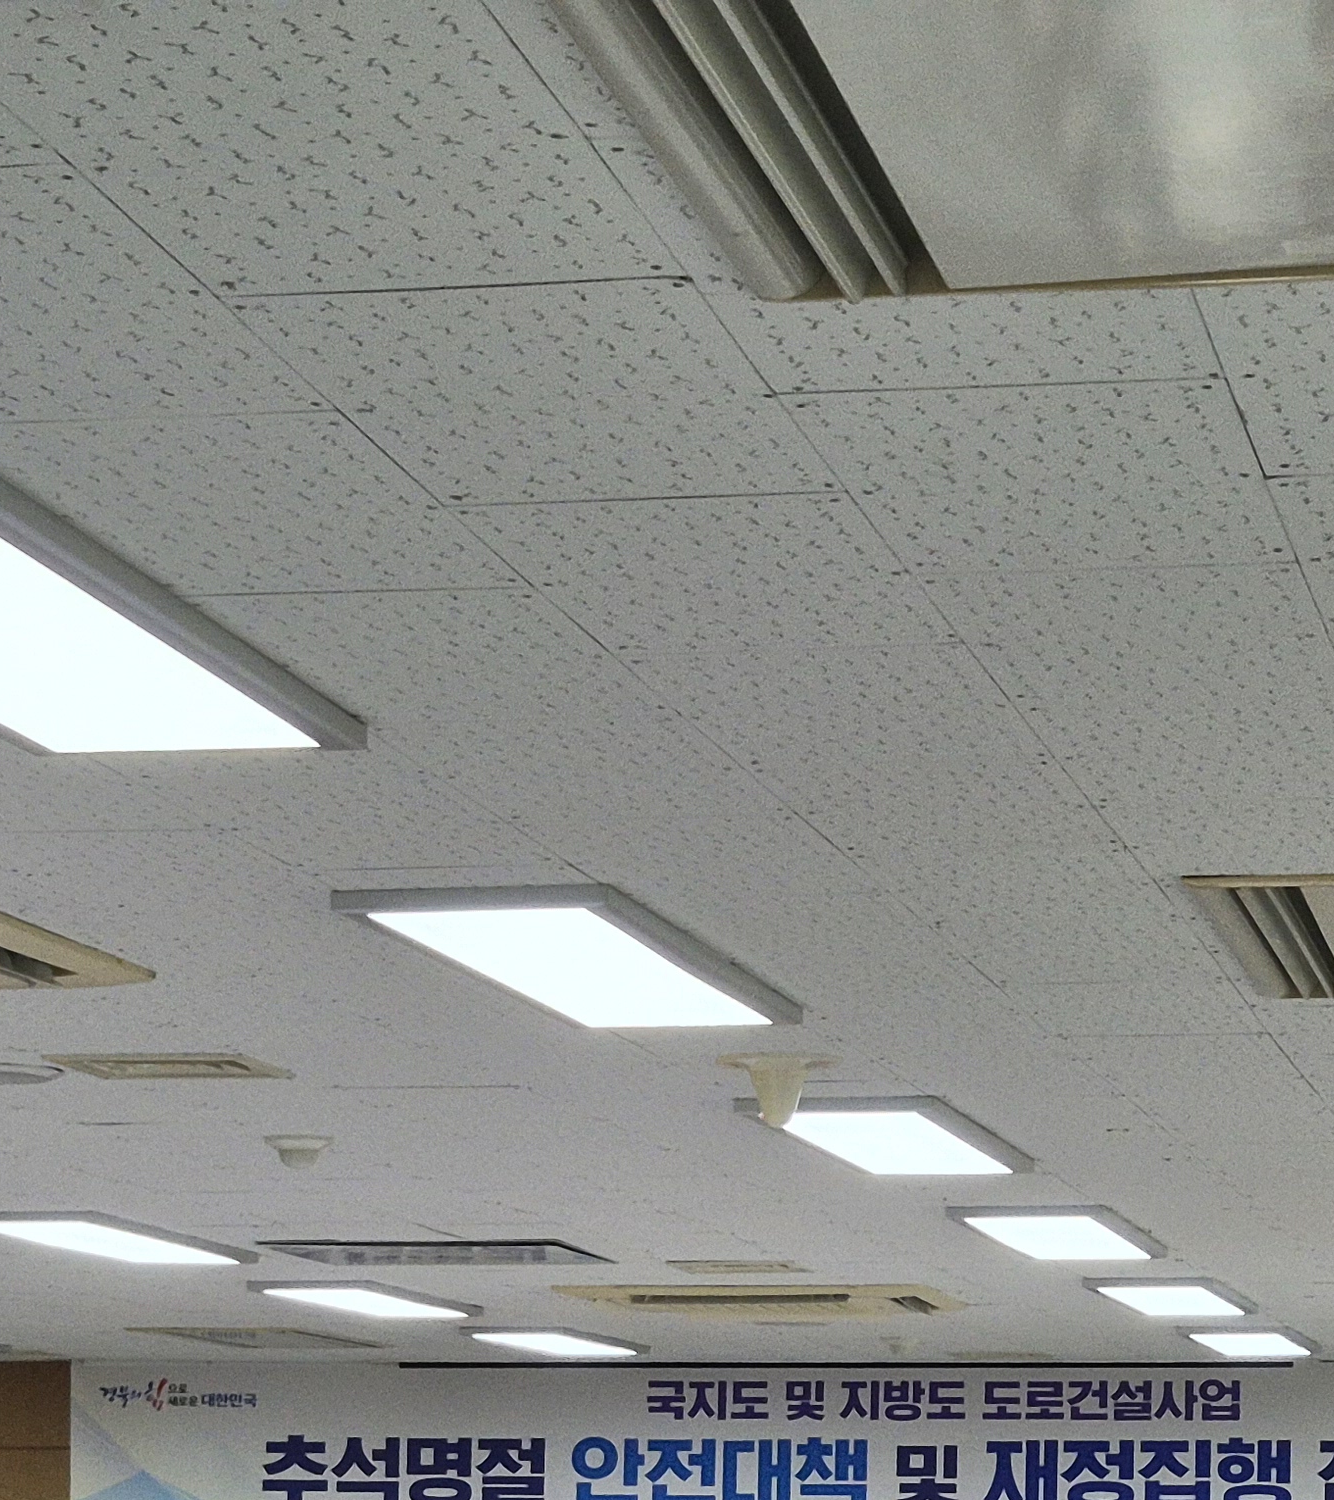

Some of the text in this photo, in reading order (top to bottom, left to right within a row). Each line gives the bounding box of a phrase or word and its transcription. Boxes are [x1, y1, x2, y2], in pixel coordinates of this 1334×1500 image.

[201, 1392, 257, 1408] 대한민국
[646, 1379, 1241, 1422] 국지도 및 지방도 도로건설사업
